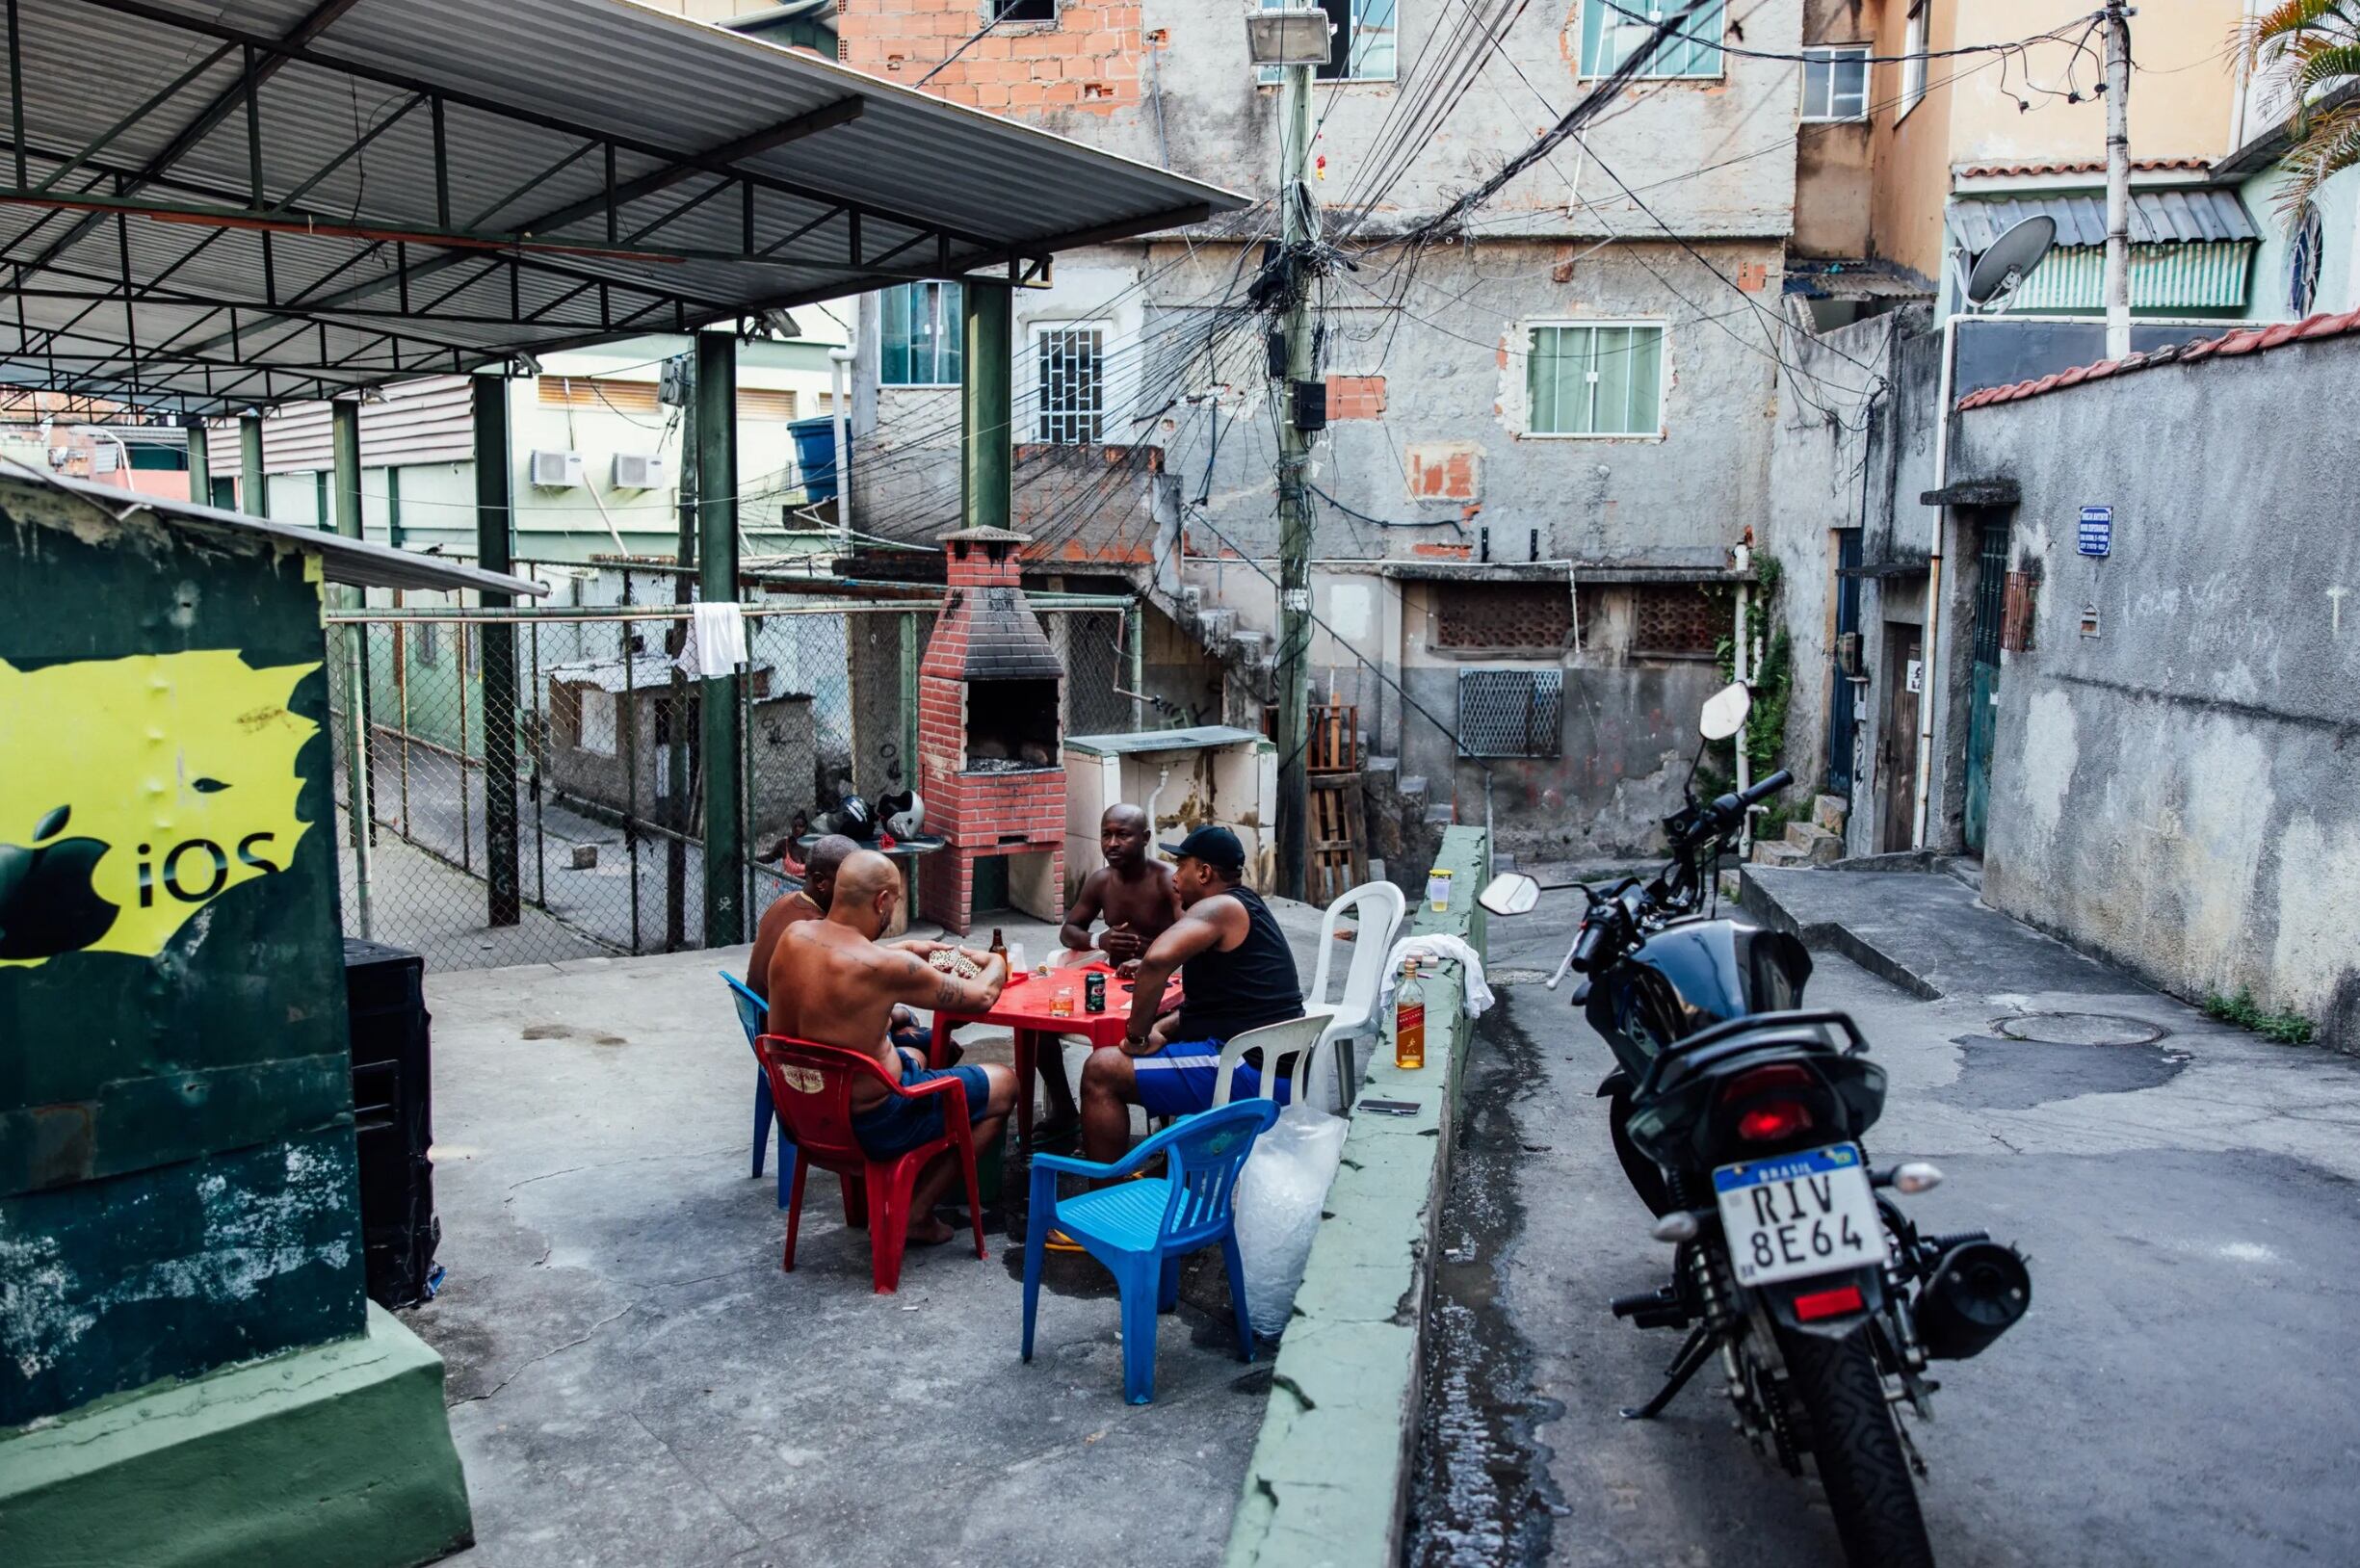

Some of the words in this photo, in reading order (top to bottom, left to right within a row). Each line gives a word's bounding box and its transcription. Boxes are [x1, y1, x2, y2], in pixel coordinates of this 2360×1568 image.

[137, 832, 278, 908] iOS
[1758, 1162, 1813, 1182] BRASIL
[1751, 1175, 1833, 1227] RIV
[1751, 1214, 1861, 1268] 8E64
